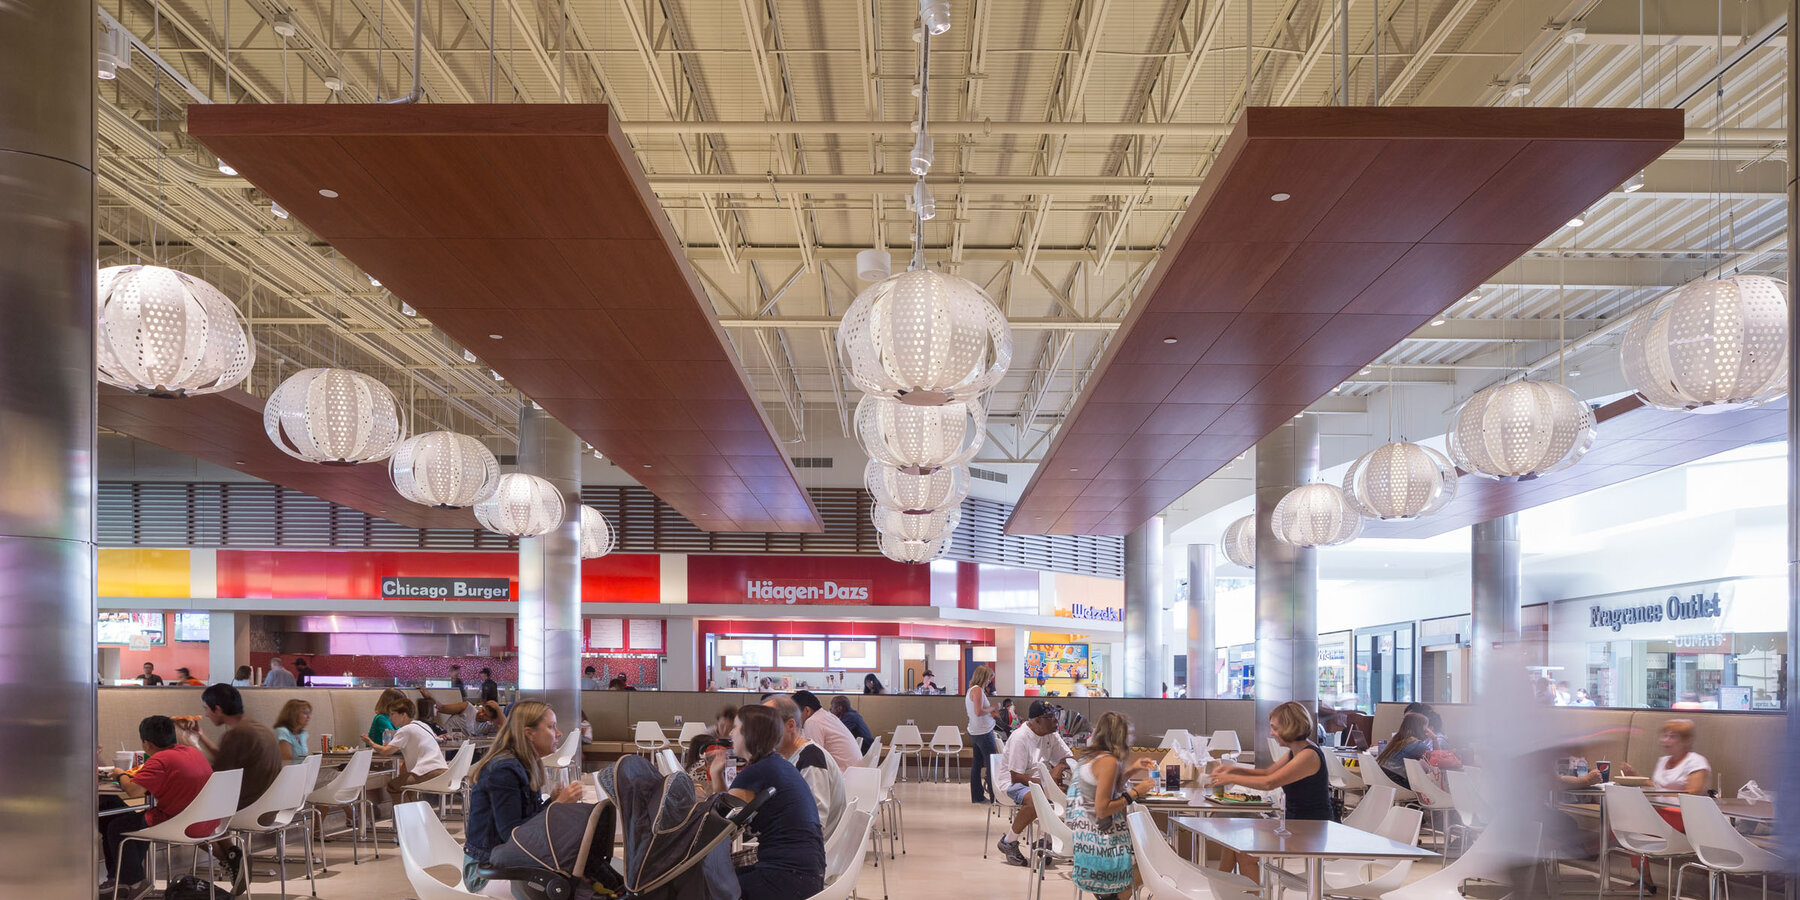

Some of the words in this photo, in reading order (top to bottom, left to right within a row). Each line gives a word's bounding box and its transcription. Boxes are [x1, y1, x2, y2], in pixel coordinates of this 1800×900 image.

[382, 578, 447, 598] Chicago
[453, 581, 508, 599] Burger
[747, 580, 868, 604] Häagen-Dazs
[1589, 604, 1663, 632] Fragrance
[1666, 592, 1721, 620] Outlet
